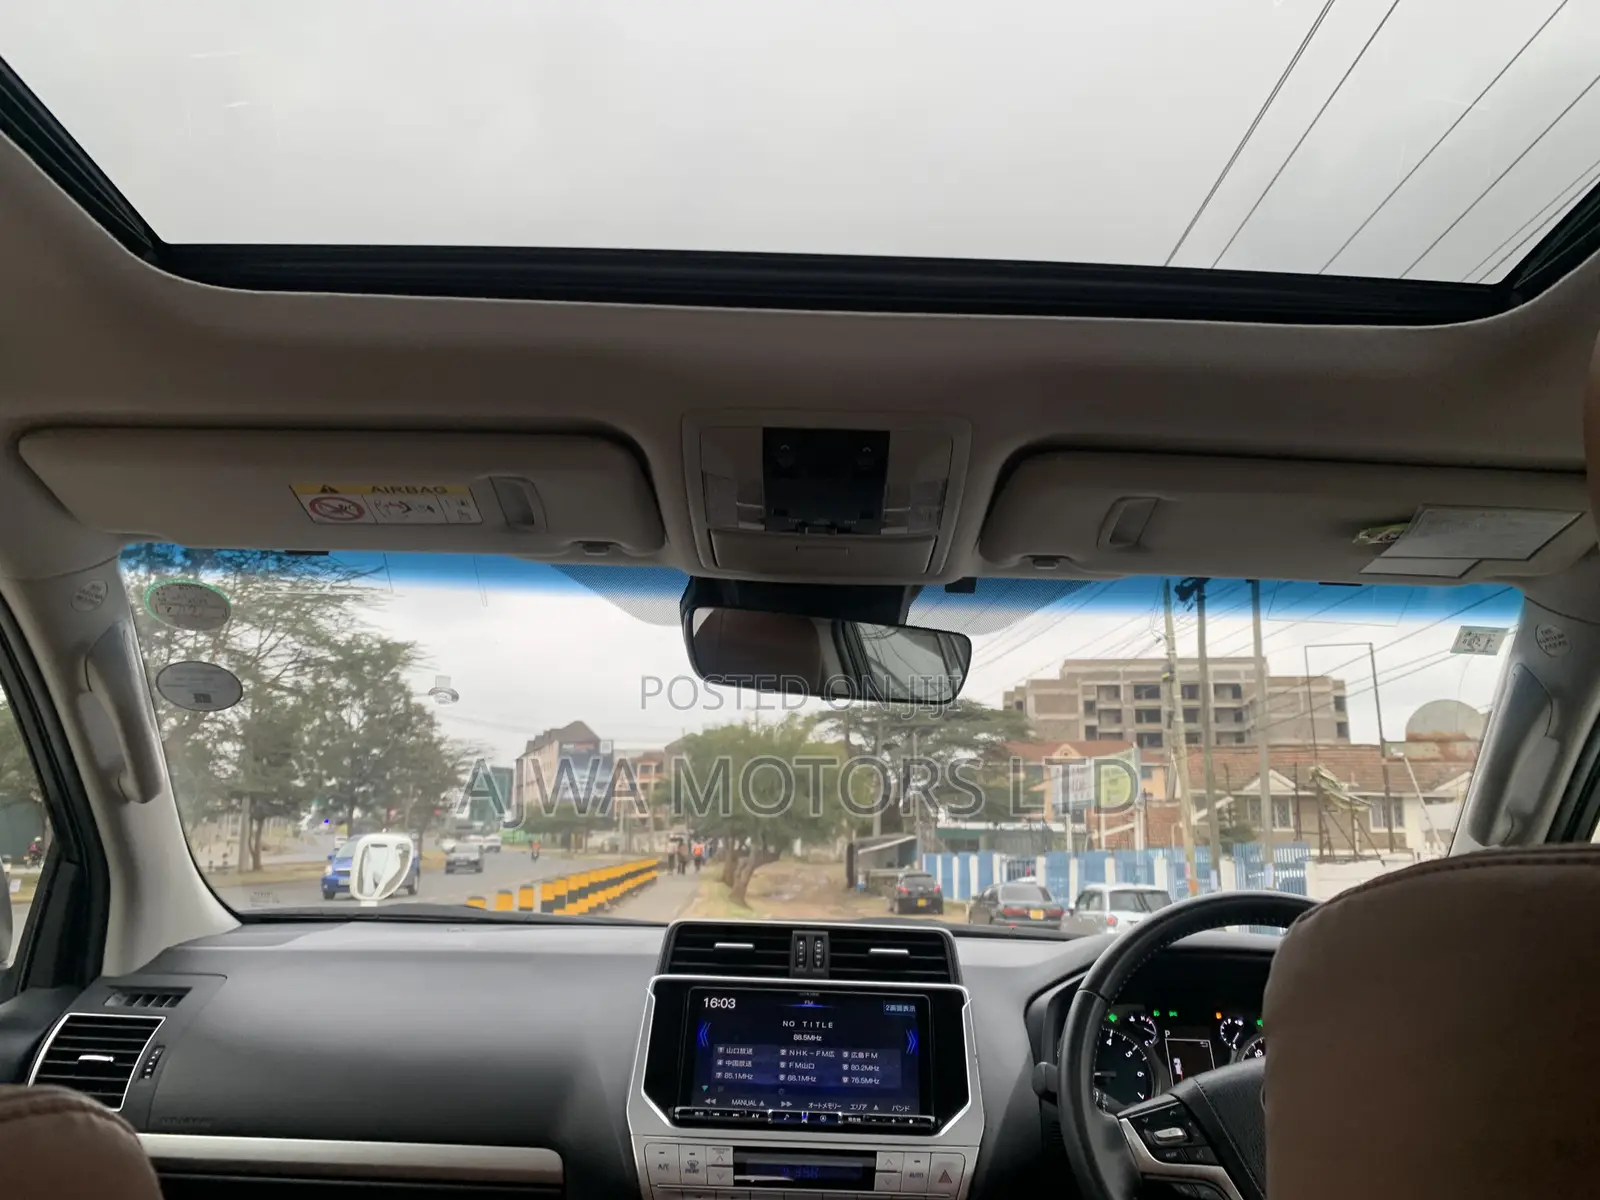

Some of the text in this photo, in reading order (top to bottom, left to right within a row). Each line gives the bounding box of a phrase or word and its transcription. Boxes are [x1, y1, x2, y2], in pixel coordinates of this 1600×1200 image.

[371, 485, 448, 495] AIRBAG
[703, 997, 736, 1008] 16:03
[802, 1021, 834, 1029] TITLE
[1106, 1038, 1112, 1046] 4
[1125, 1050, 1133, 1058] 5
[731, 1099, 756, 1107] MANUAL
